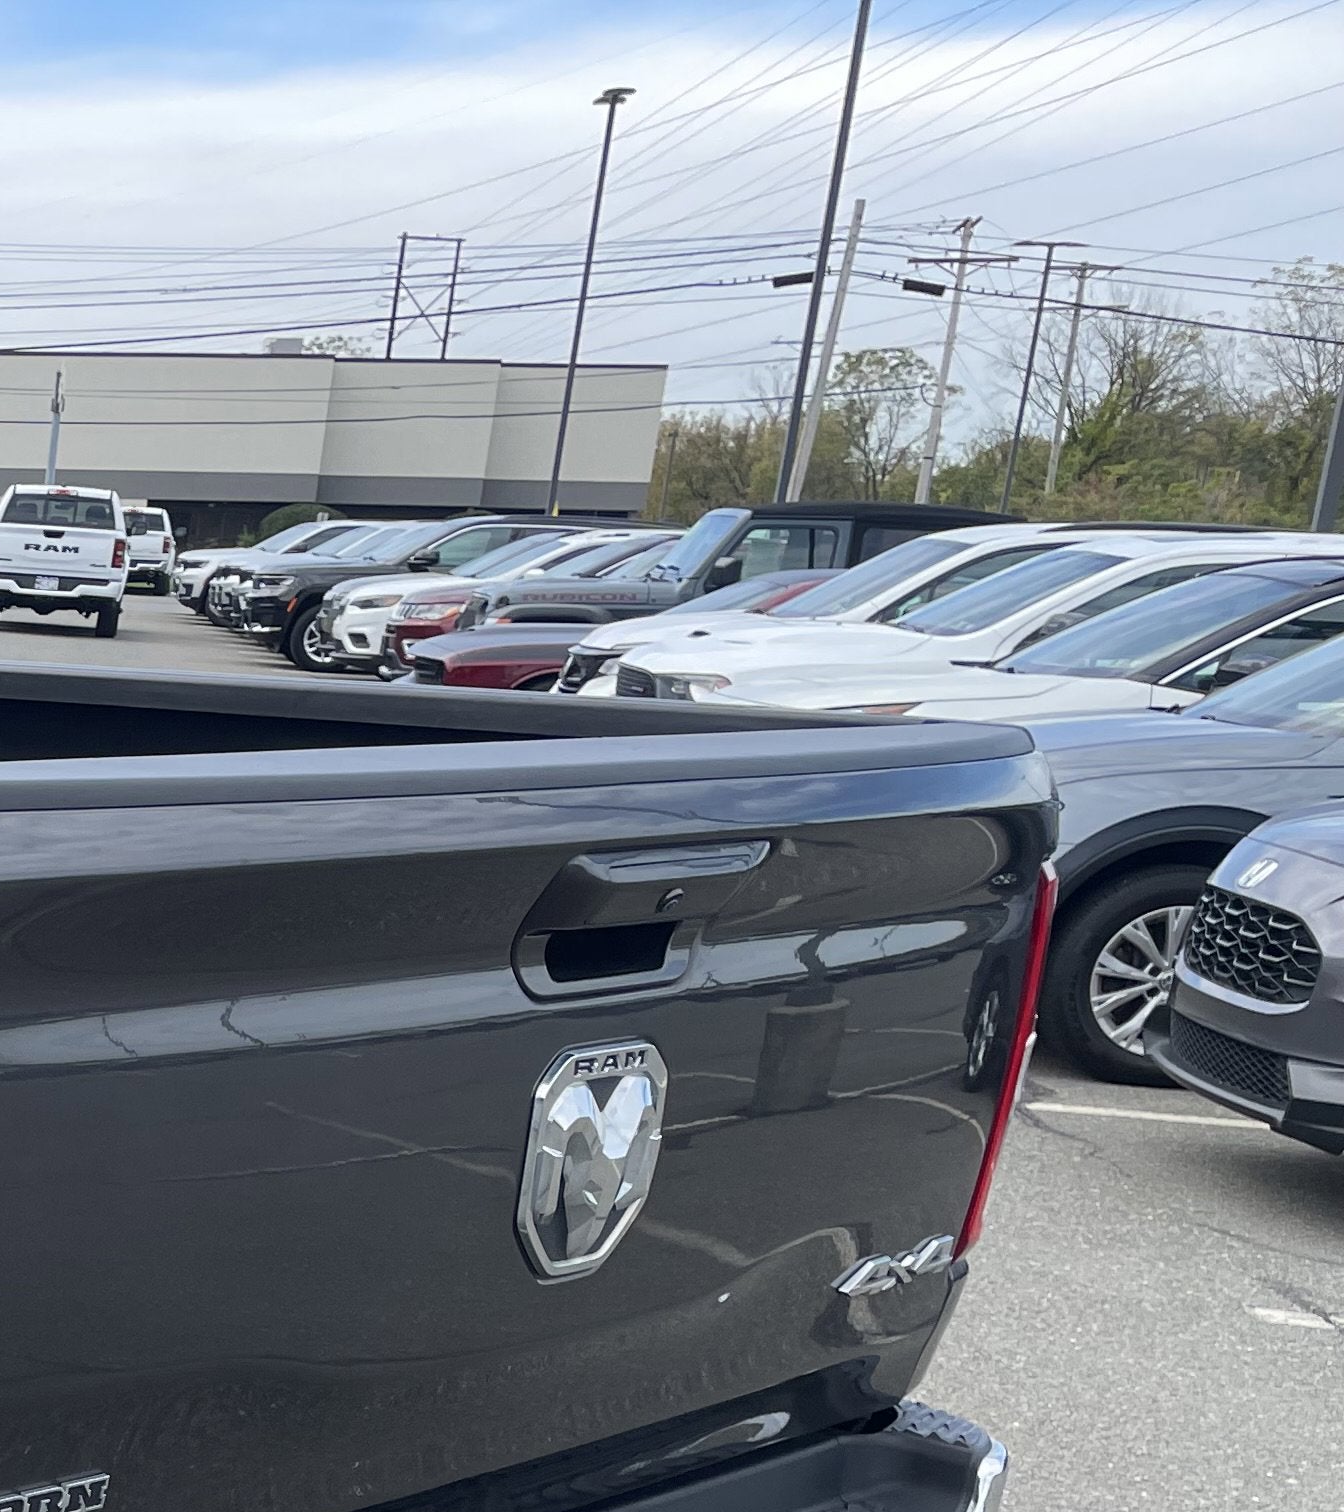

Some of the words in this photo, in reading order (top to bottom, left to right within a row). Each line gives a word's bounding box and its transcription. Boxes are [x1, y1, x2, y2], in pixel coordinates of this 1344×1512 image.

[24, 543, 80, 554] RAM
[522, 591, 638, 603] RUBICON
[572, 1049, 649, 1078] RAM
